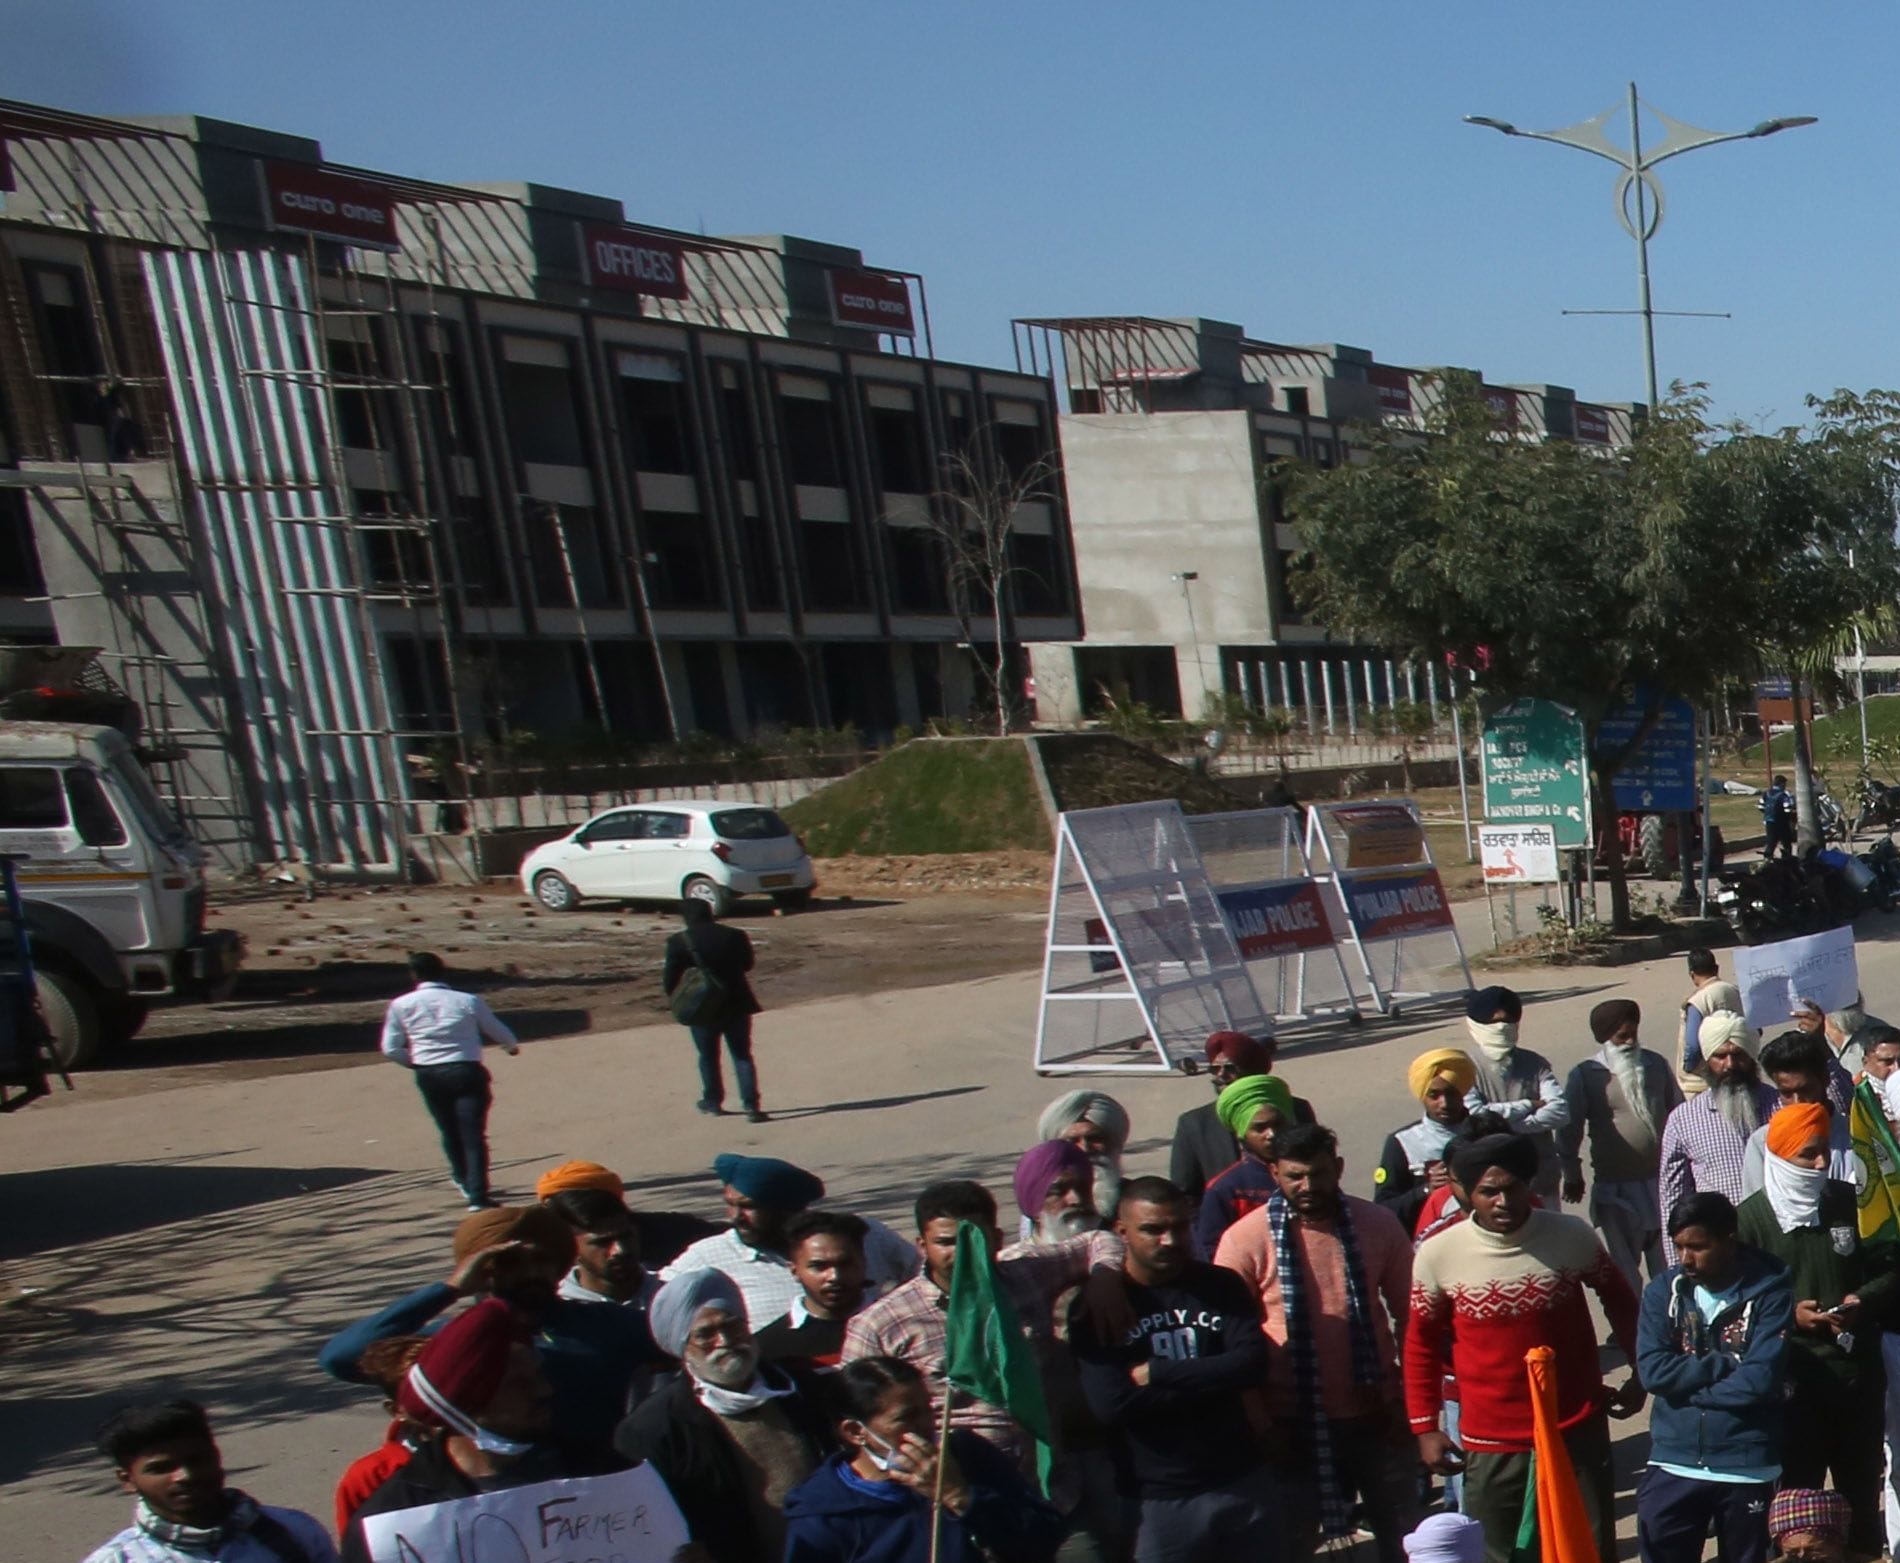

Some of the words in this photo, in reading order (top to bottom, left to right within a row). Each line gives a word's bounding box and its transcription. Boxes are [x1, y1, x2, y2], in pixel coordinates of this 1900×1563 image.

[281, 191, 337, 215] curo
[342, 203, 386, 224] one
[595, 240, 677, 284] OFFICES
[879, 300, 906, 316] one
[540, 1497, 649, 1550] FARMER
